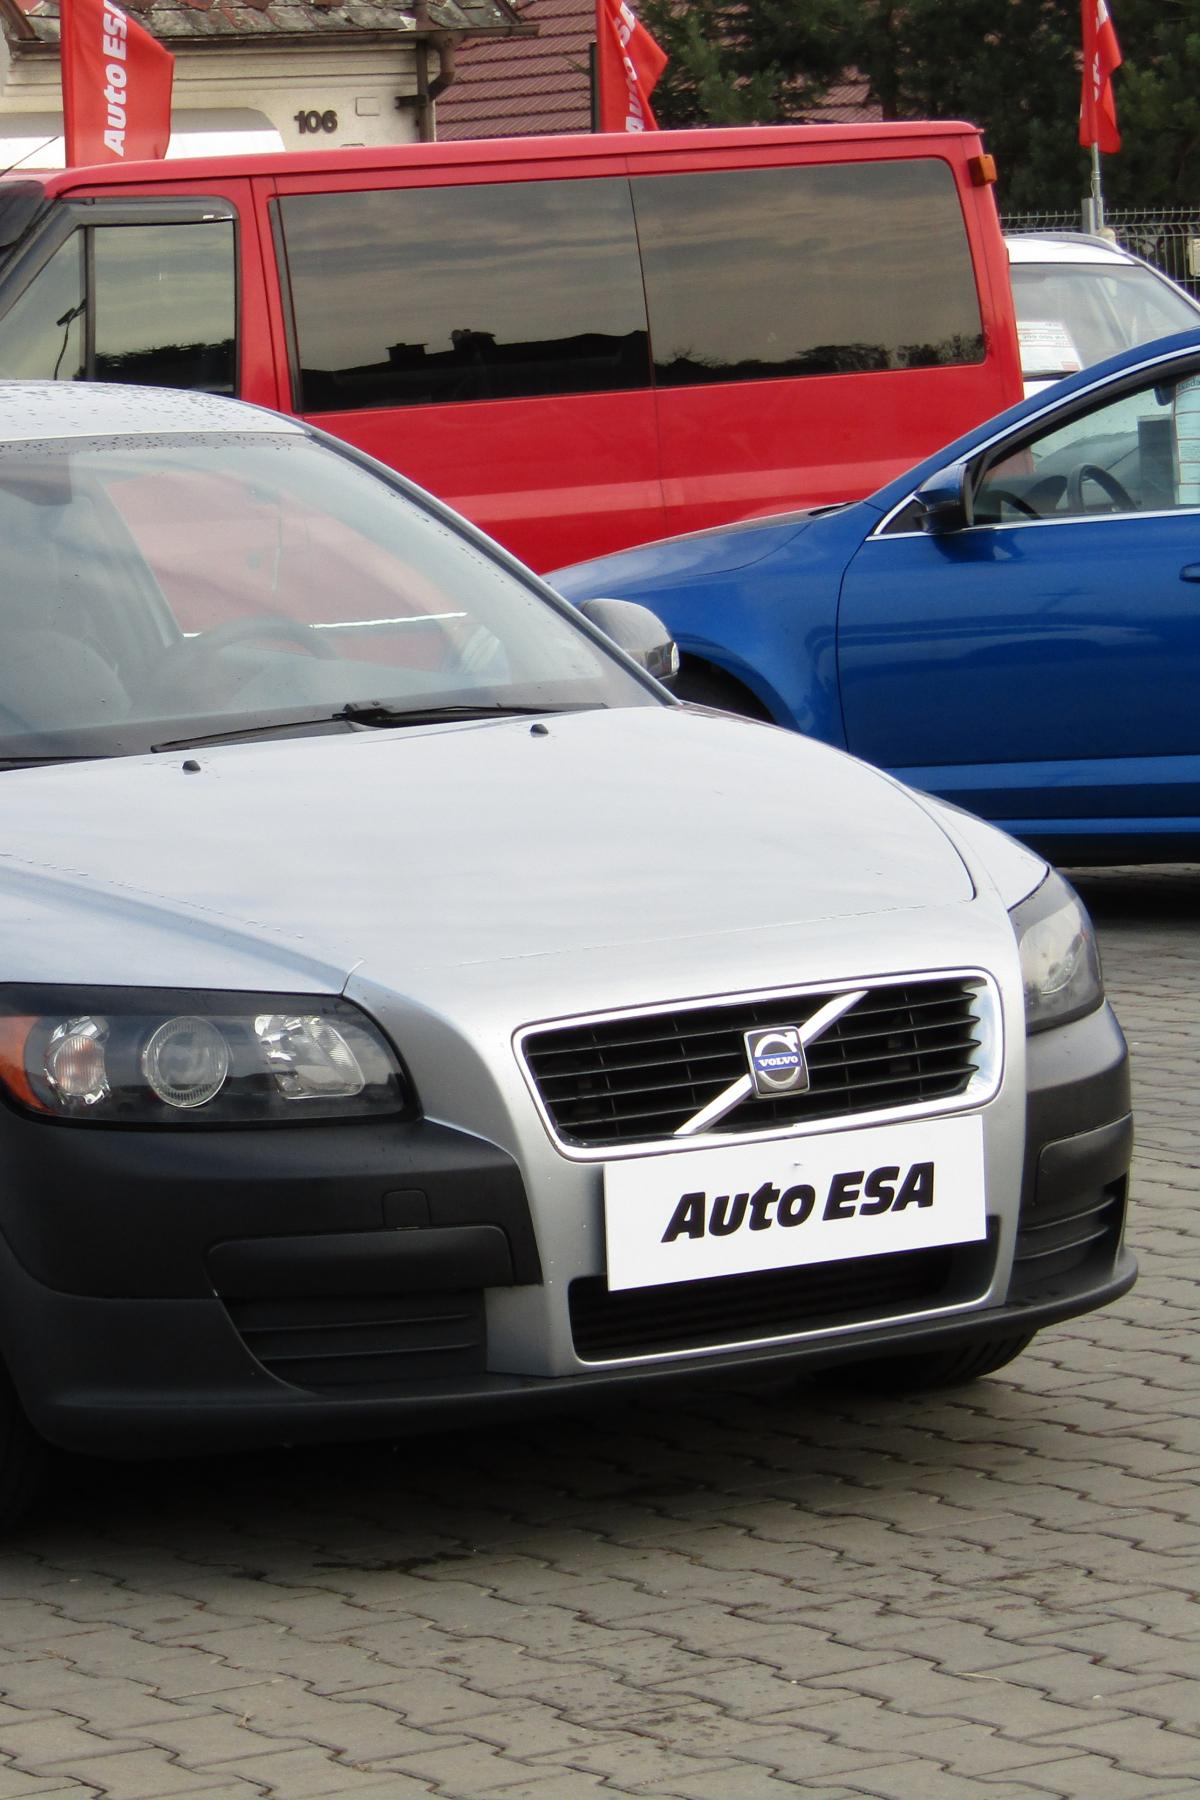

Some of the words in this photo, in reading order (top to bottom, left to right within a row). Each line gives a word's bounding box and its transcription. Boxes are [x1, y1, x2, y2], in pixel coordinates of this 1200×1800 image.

[103, 63, 128, 157] Auto
[293, 110, 338, 134] 106
[758, 1055, 799, 1067] VOLVO
[660, 1182, 817, 1244] Auto
[822, 1161, 935, 1222] ESA
